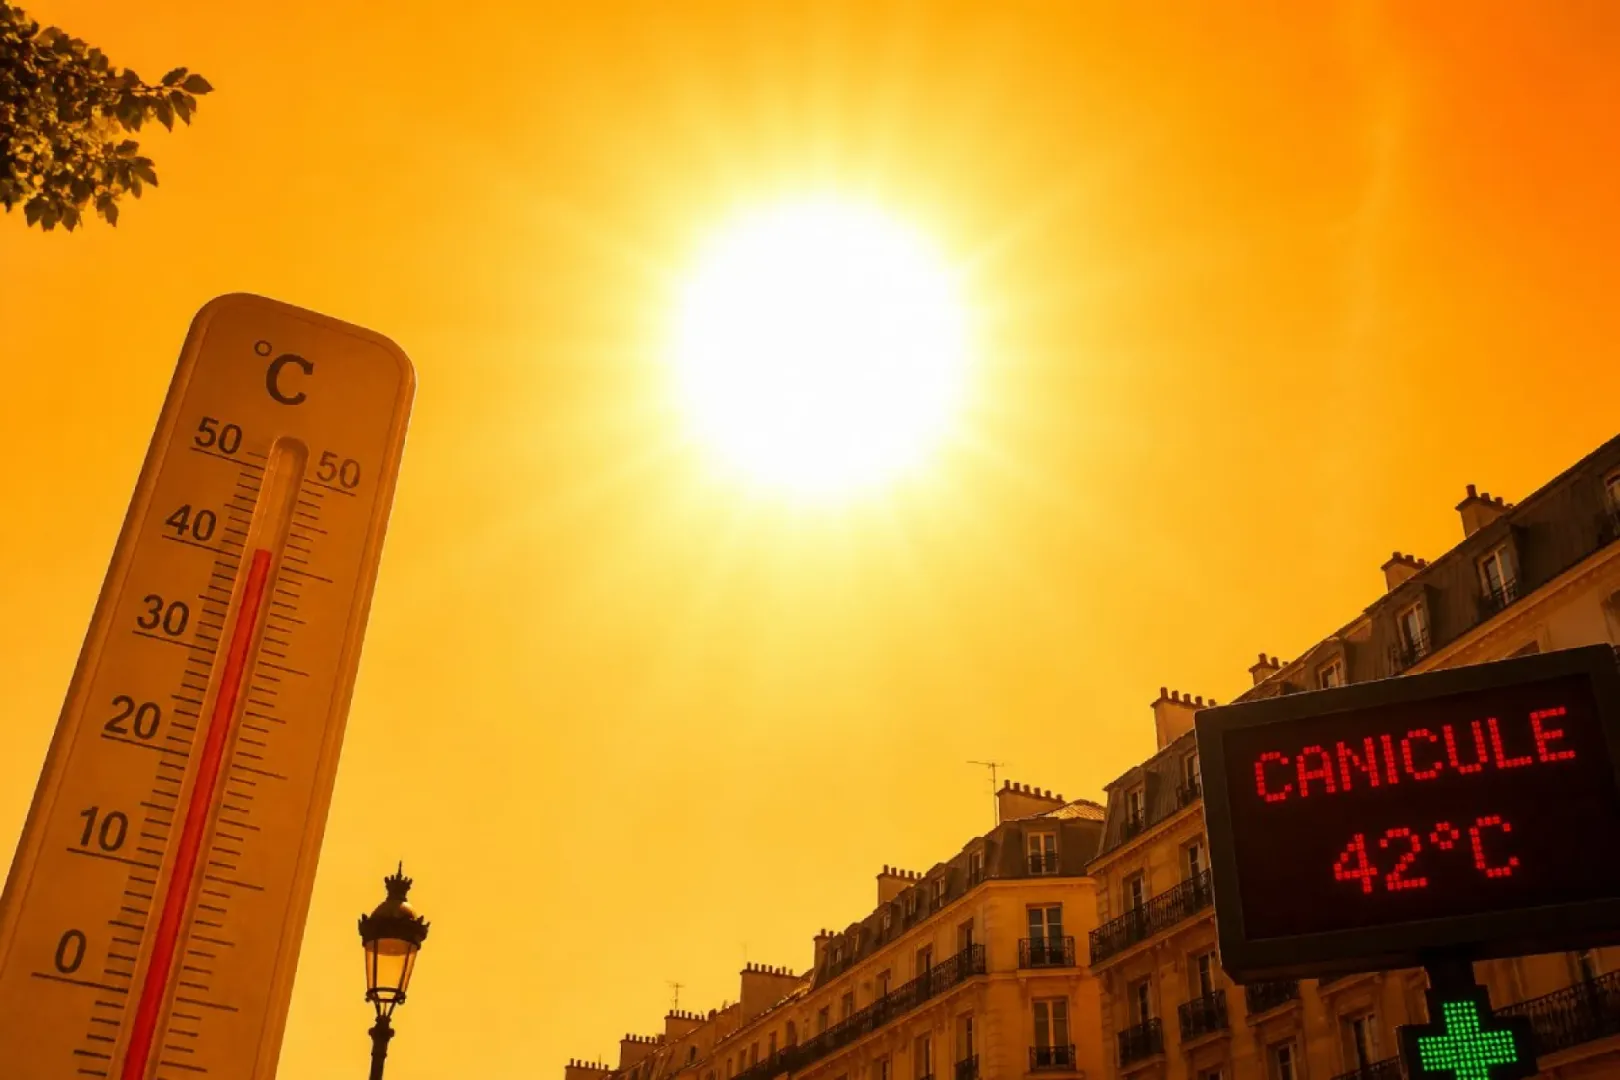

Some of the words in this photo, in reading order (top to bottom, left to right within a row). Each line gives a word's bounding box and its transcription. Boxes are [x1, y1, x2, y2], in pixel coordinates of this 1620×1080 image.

[194, 416, 243, 455] 50
[316, 451, 361, 489] 50
[165, 504, 217, 541] 40
[136, 594, 190, 636] 30
[103, 694, 161, 740] 20
[1254, 706, 1576, 802] CANICULE
[79, 805, 129, 852] 10
[1333, 814, 1520, 893] 42°C
[54, 929, 87, 974] 0
